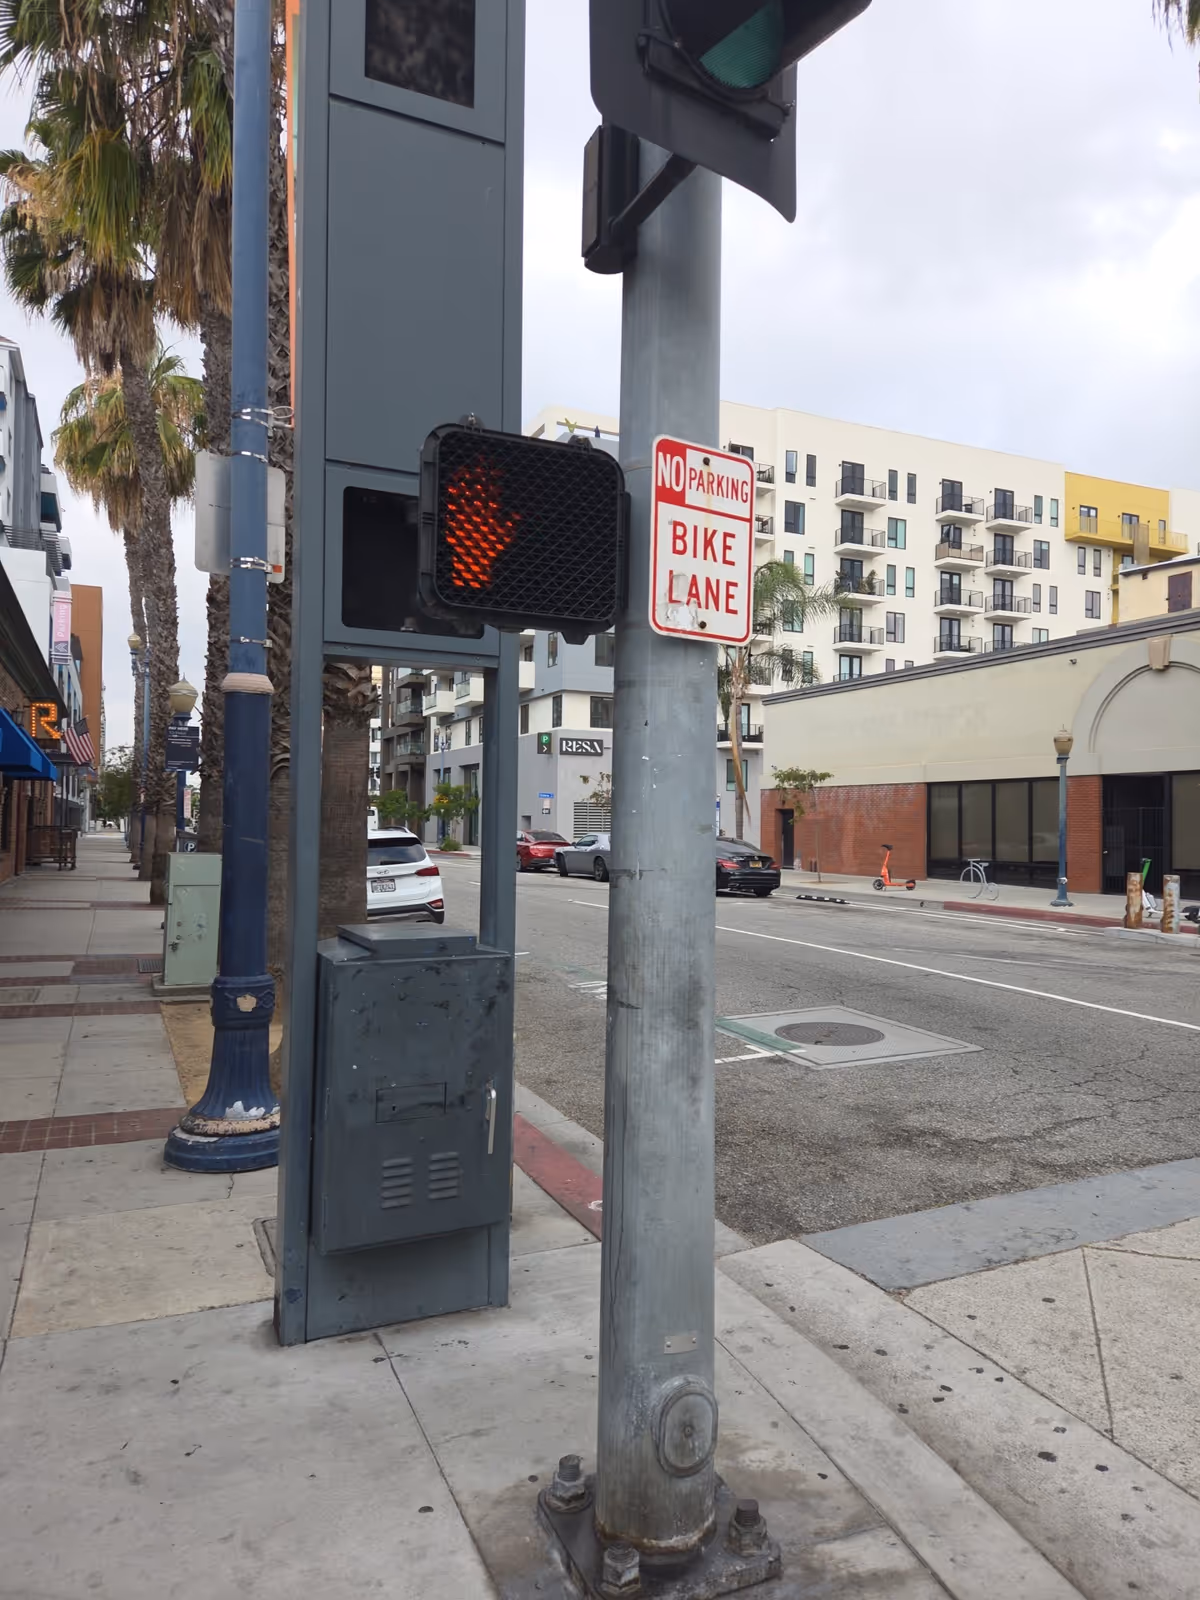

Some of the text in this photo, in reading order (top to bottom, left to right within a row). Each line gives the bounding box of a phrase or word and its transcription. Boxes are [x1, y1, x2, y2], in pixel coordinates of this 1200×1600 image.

[657, 451, 749, 504] NO PARKING
[672, 520, 736, 566] BIKE
[668, 569, 738, 615] LANE
[31, 702, 62, 740] R
[542, 735, 549, 743] P
[562, 740, 602, 753] RESA
[187, 843, 195, 851] P
